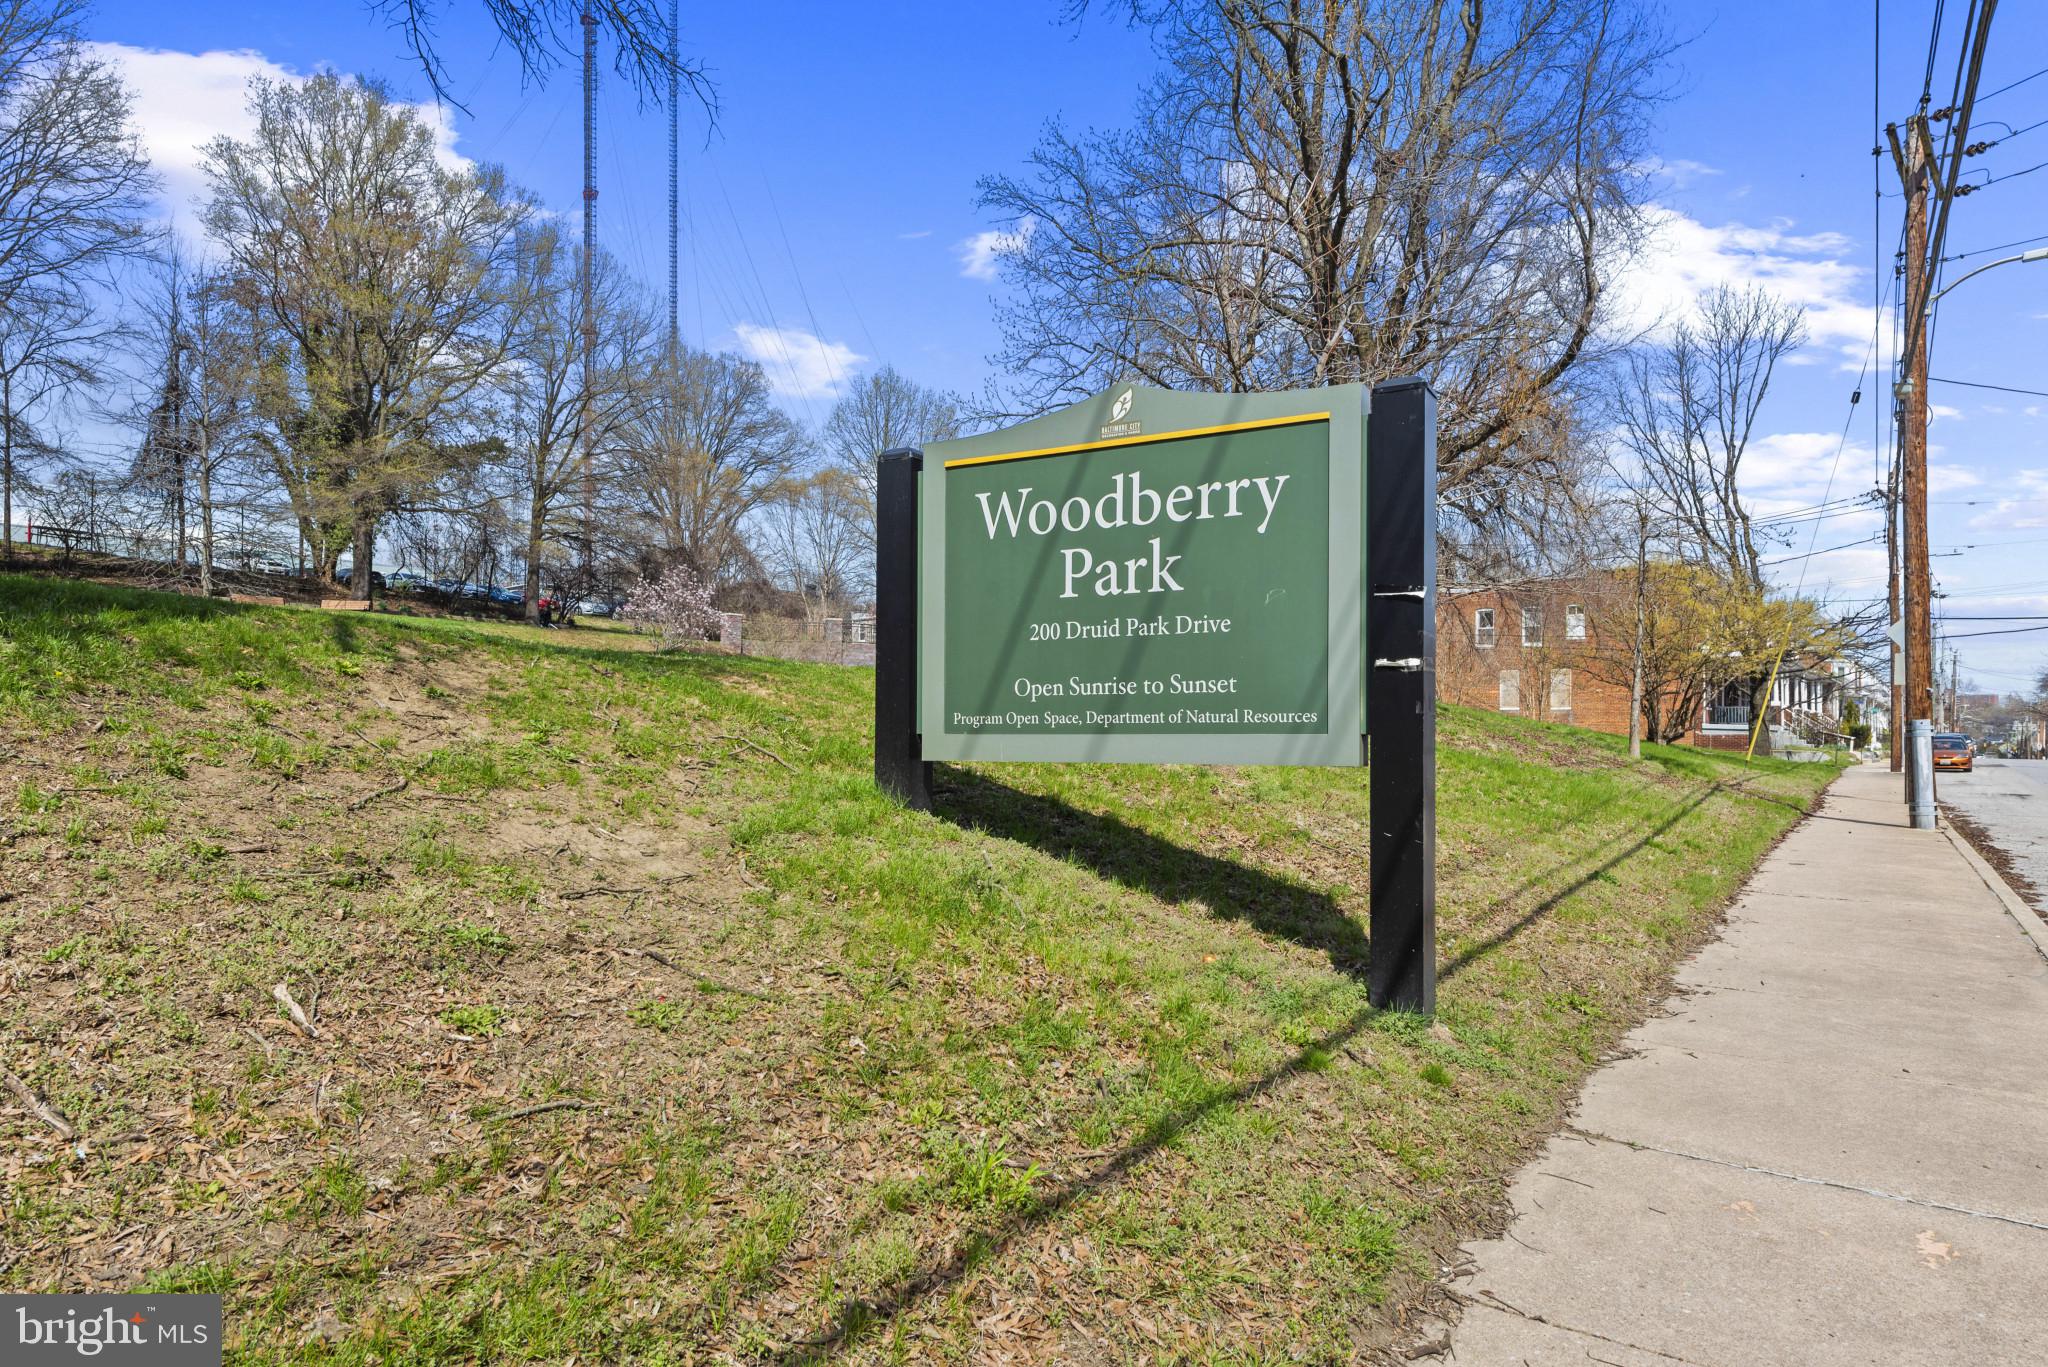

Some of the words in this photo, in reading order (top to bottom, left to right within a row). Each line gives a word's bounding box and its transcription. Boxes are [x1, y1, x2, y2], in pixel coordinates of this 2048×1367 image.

[975, 471, 1290, 540] Woodberry
[1060, 537, 1184, 598] Park
[1029, 622, 1060, 641] 200
[1066, 618, 1120, 639] Druid
[1126, 617, 1169, 638] Park
[1175, 614, 1232, 636] Drive
[1014, 677, 1064, 702] Open
[1069, 676, 1137, 697] Sunrise
[1143, 679, 1164, 695] to
[1170, 674, 1237, 695] Sunset
[953, 711, 1003, 727] Program
[1006, 711, 1039, 727] Open
[1044, 710, 1083, 727] Space,
[1086, 710, 1164, 726] Department
[1168, 709, 1183, 724] of
[1186, 708, 1239, 724] Natural
[1243, 710, 1318, 724] Resources
